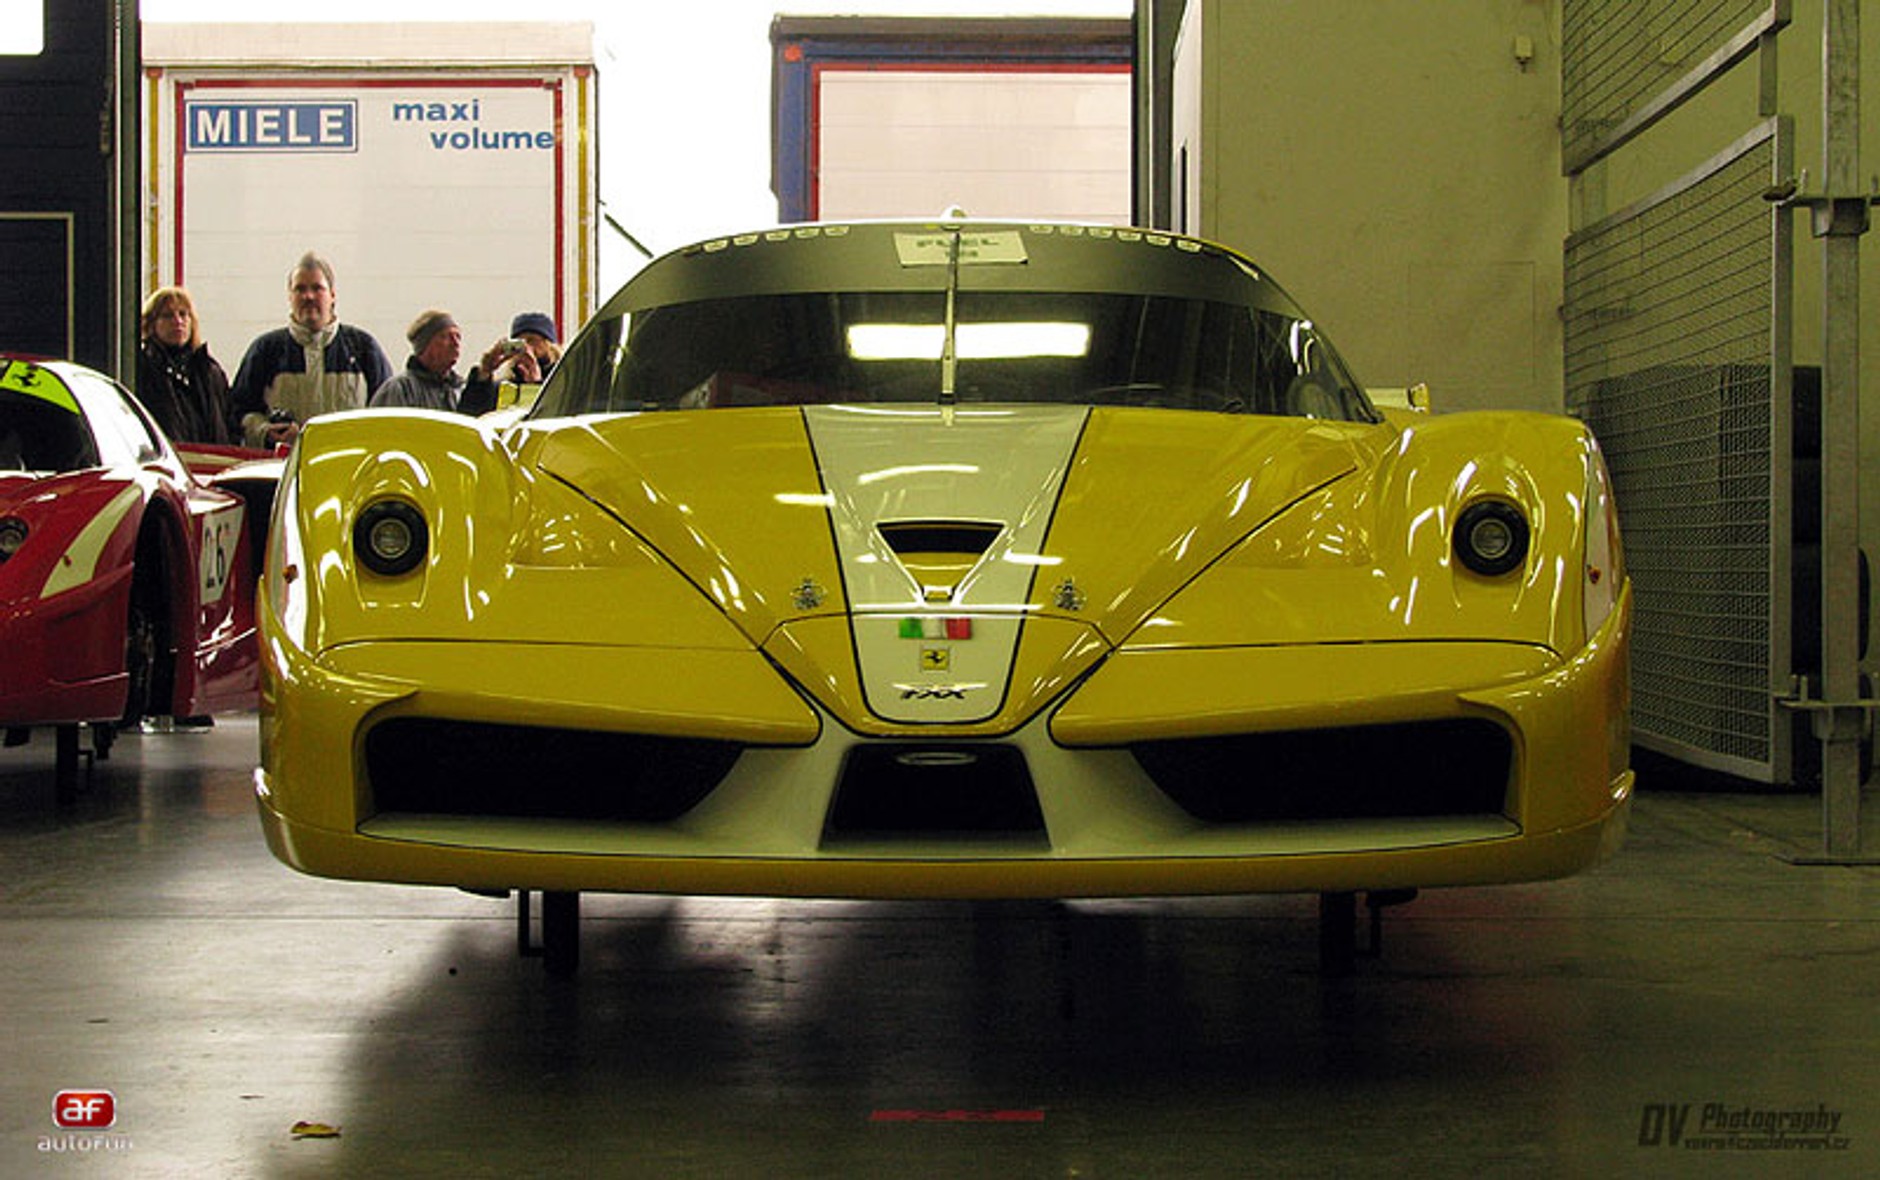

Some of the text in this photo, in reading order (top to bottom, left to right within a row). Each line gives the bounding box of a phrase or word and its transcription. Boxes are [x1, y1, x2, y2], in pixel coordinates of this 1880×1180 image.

[392, 98, 480, 122] maxi
[196, 108, 346, 145] MIELE
[430, 126, 555, 150] volume
